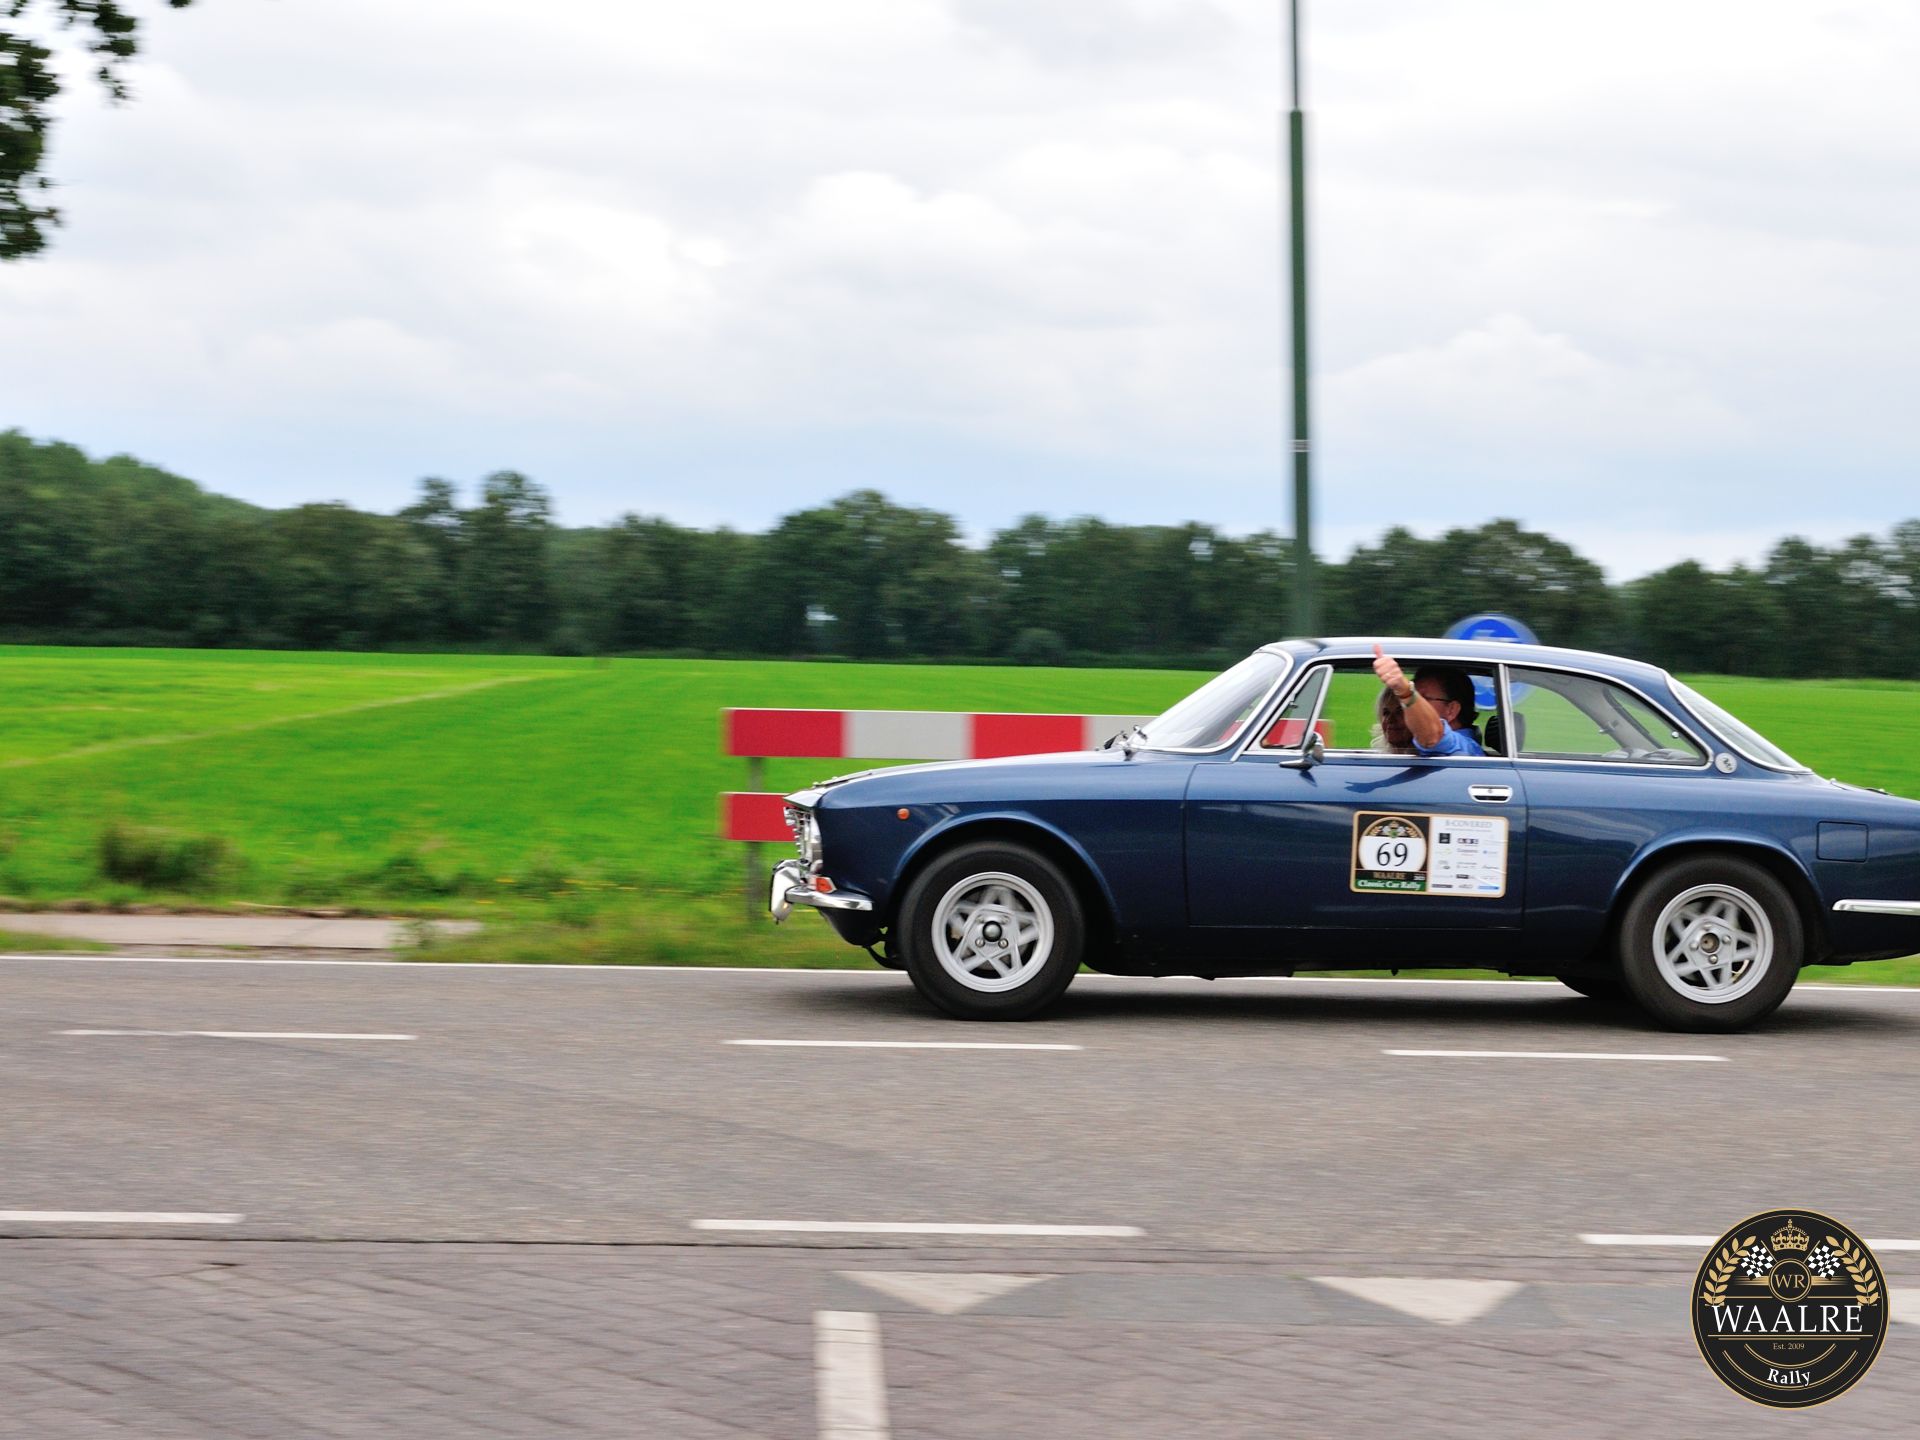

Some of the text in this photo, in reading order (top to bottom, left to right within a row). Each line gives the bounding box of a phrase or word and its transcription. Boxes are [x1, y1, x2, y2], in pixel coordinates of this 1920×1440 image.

[1376, 842, 1408, 867] 69
[1373, 872, 1405, 880] WAALRE
[1357, 880, 1385, 888] Classic
[1401, 881, 1421, 890] Rally
